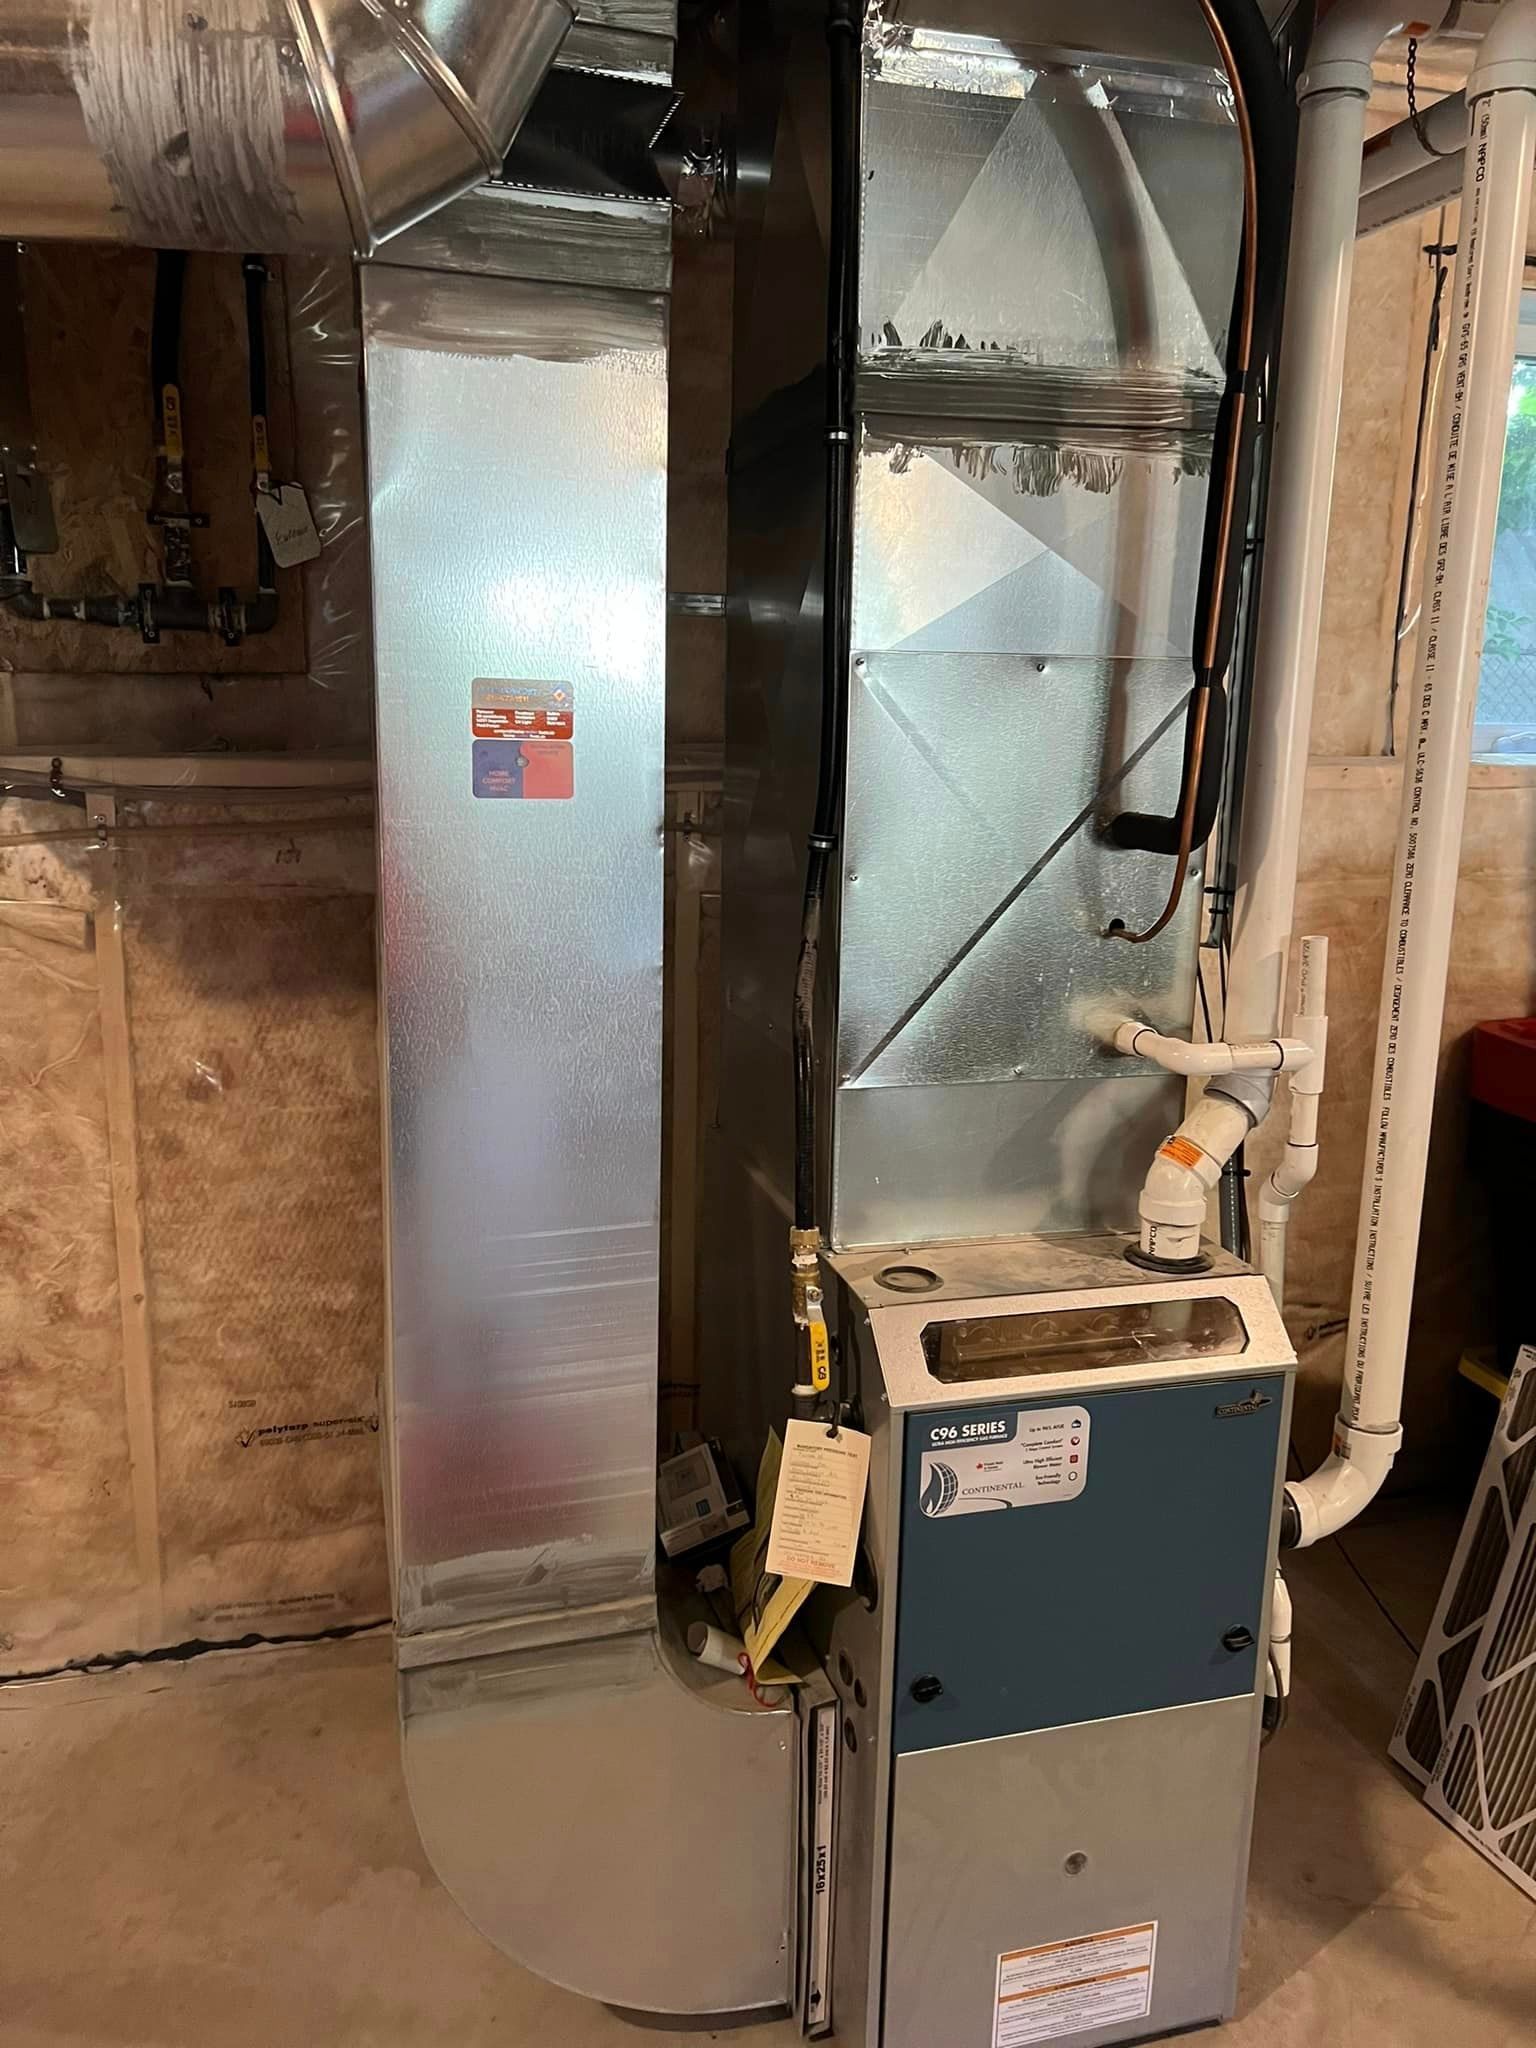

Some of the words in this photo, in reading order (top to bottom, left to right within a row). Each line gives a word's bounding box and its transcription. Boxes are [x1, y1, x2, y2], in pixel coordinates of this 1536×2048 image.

[1476, 142, 1487, 182] NAPCO
[1449, 412, 1461, 448] CONDUITE
[1448, 450, 1457, 461] DE
[1446, 462, 1456, 481] MISE
[1440, 517, 1449, 539] LIBRE
[1439, 541, 1447, 556] DES
[1432, 590, 1442, 612] CLASS
[1427, 634, 1437, 661] CLASSE
[1423, 694, 1431, 708] DEG
[1411, 786, 1422, 814] CONTROL
[1405, 862, 1414, 879] ZERO
[1402, 880, 1412, 916] CLEARANCE
[1400, 918, 1408, 927] TO
[1396, 928, 1408, 974] COMBUSTIBLES
[1390, 1024, 1398, 1040] ZERO
[1388, 1042, 1396, 1054] DES
[1383, 1056, 1395, 1101] COMBUSTIBLES
[1380, 1106, 1390, 1129] FOLLOW
[1371, 1184, 1382, 1227] INSTALLATION
[1366, 1229, 1377, 1271] INSTRUCTIONS
[1363, 1279, 1372, 1301] SUIVRE
[1362, 1302, 1370, 1315] LES
[1358, 1316, 1368, 1358] INSTRUCTIONS
[1357, 1359, 1364, 1369] DU
[930, 1427, 958, 1441] C96
[961, 1420, 1006, 1437] SERIES
[961, 1482, 1024, 1496] CONTINENTAL
